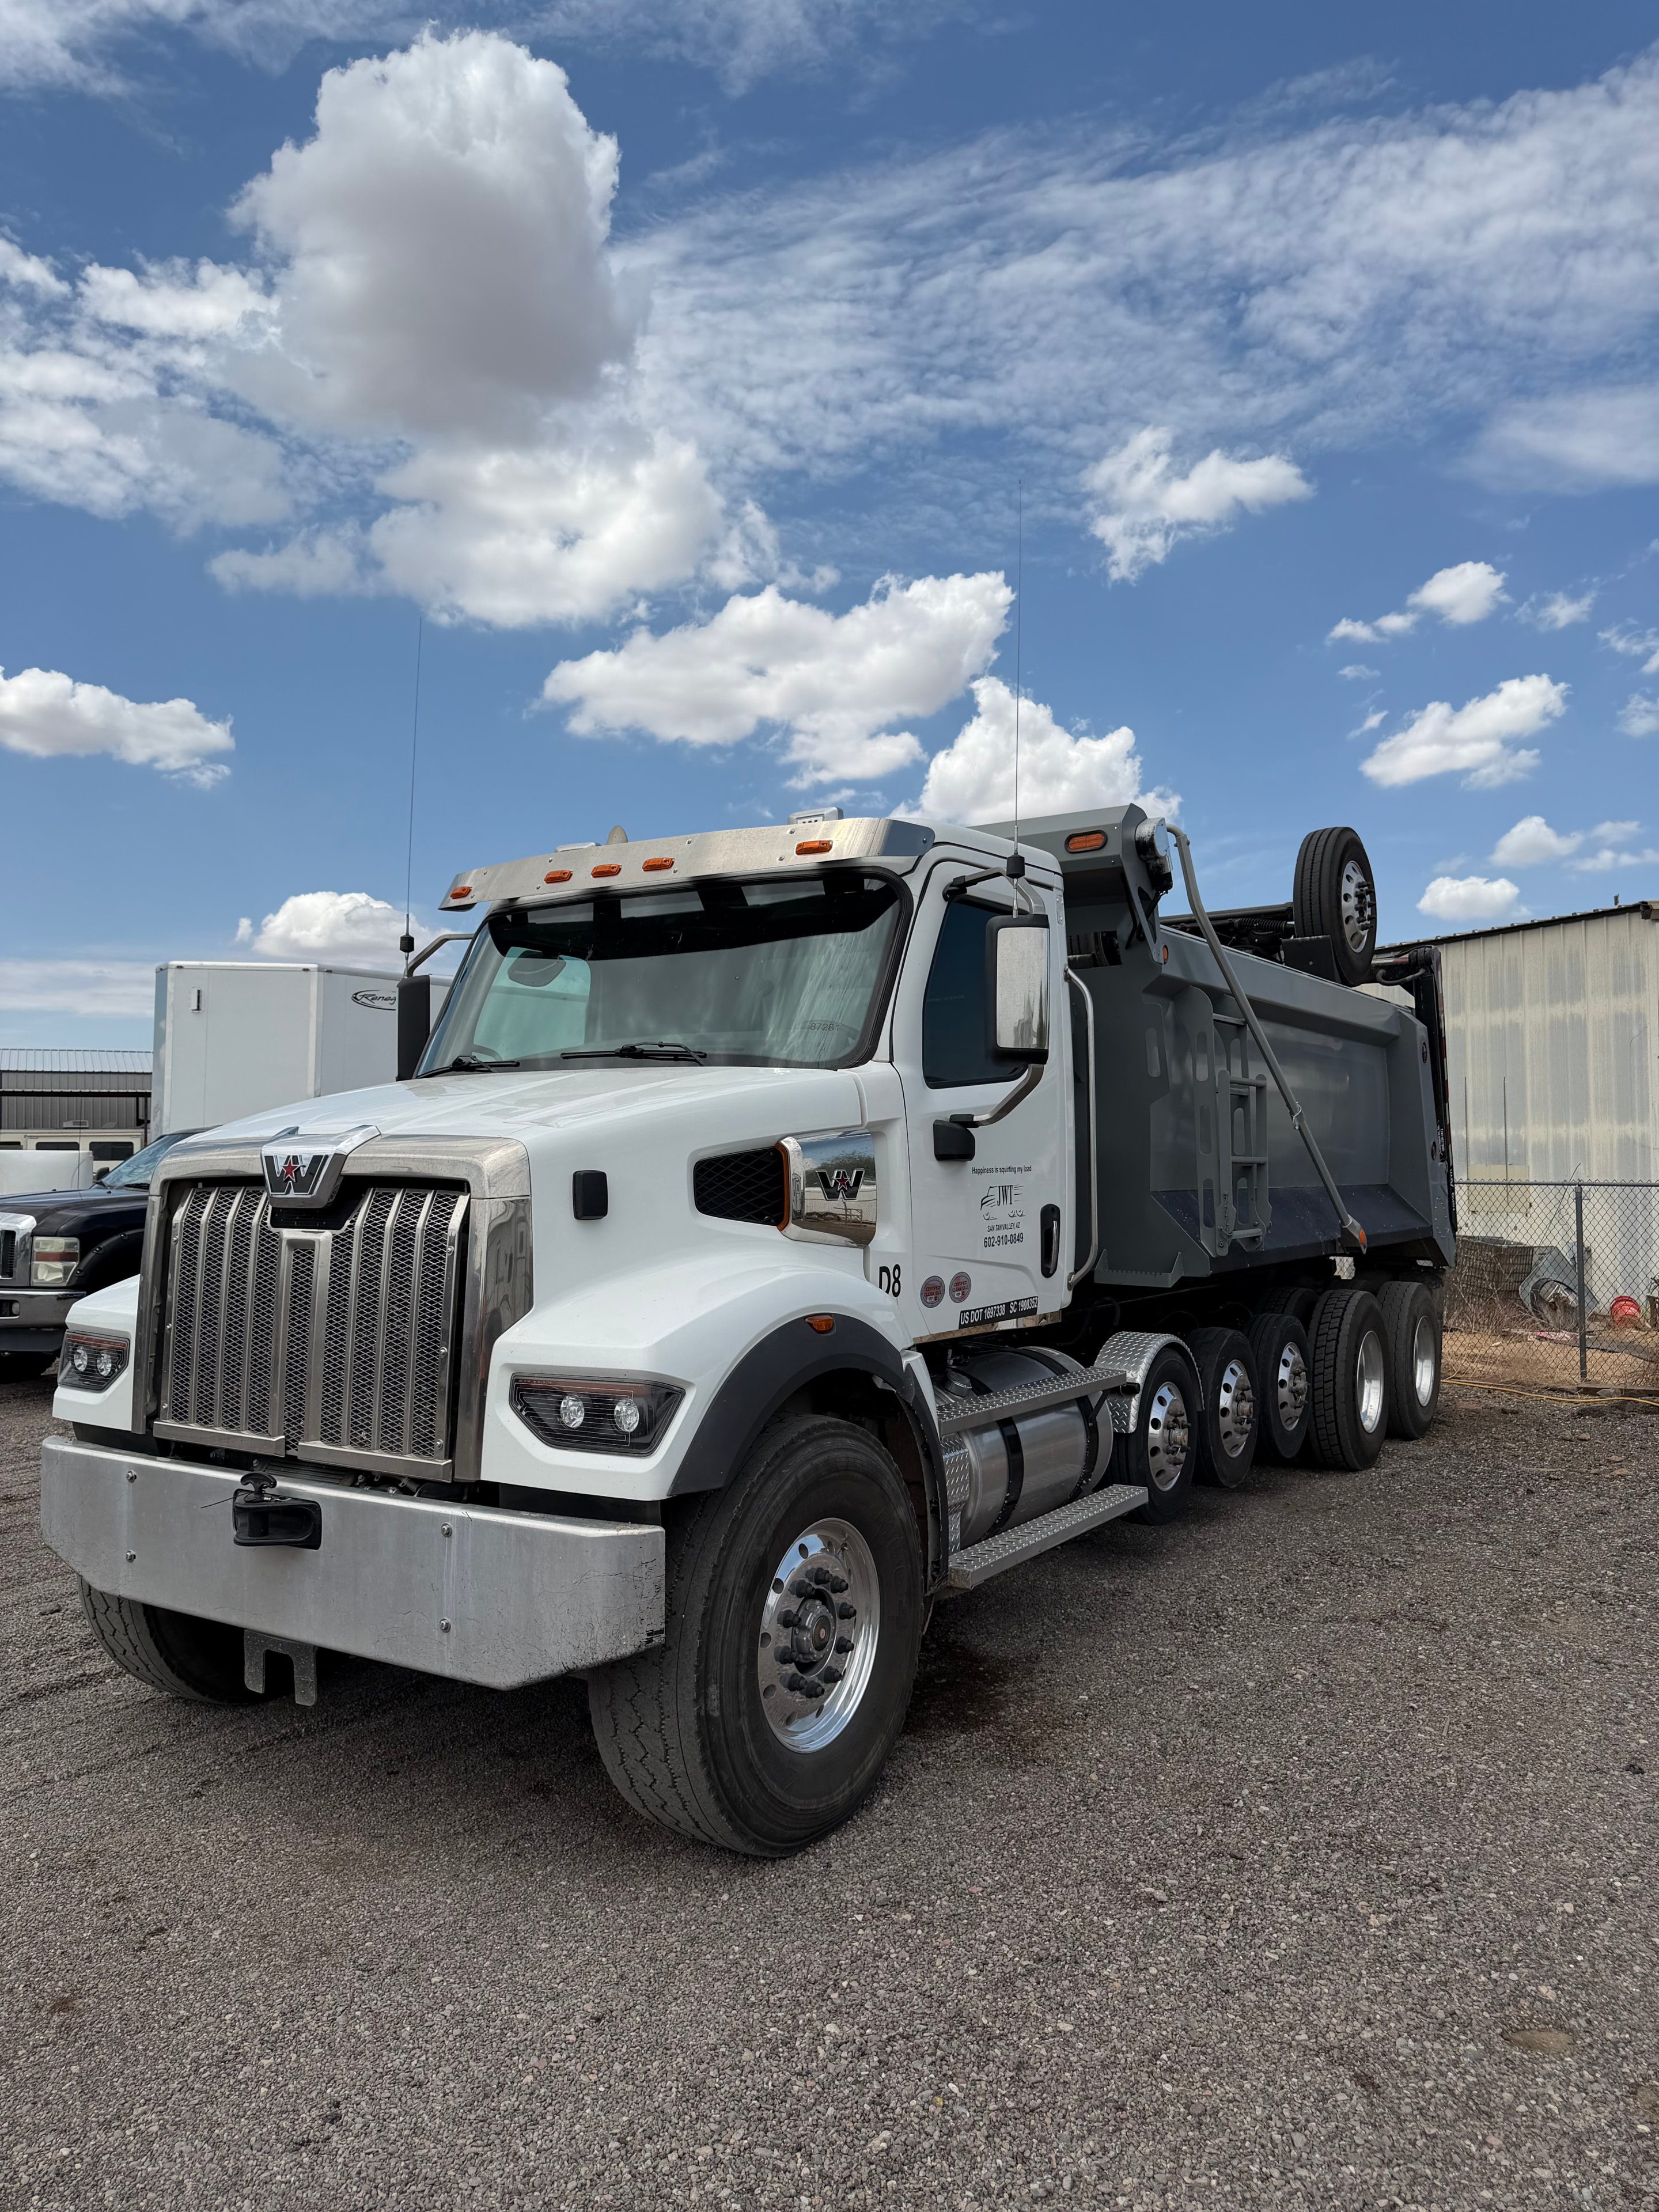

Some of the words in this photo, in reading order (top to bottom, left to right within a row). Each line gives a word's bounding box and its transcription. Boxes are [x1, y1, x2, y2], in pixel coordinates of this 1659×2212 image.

[810, 1022, 839, 1032] 87281
[972, 1166, 994, 1175] Happiness
[997, 1184, 1013, 1206] JWT
[984, 1232, 1024, 1248] 602-910-0849
[878, 1263, 901, 1298] D8
[960, 1312, 969, 1325] US
[970, 1309, 983, 1323] DOT
[984, 1304, 1006, 1320] 1697338
[1009, 1301, 1017, 1313] SC
[1018, 1297, 1037, 1312] 1900352
